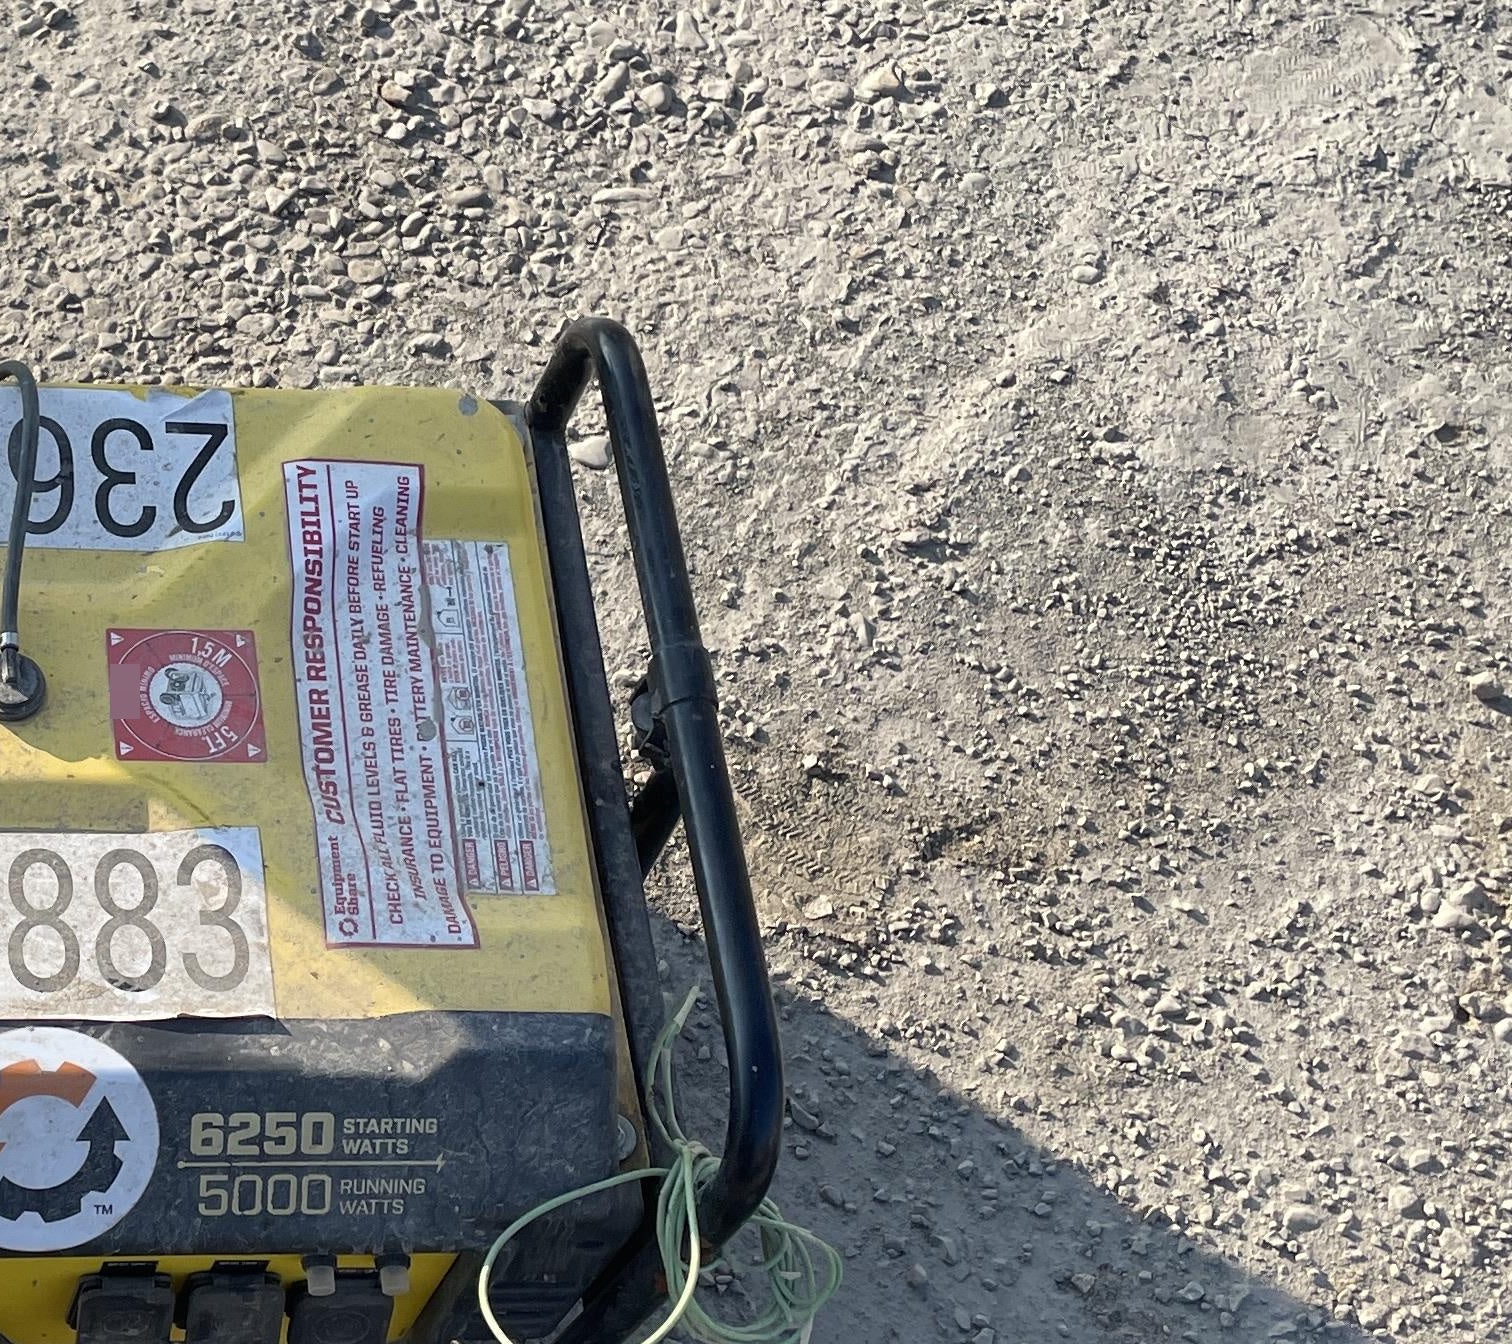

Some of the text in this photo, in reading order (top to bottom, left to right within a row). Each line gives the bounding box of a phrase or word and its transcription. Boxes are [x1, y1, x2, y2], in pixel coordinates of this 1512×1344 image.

[213, 649, 232, 667] M
[296, 465, 345, 824] CUSTOMER RESPONSIBILITY
[345, 480, 403, 924] CHECK ALL FLUID LEVELS & GREASE DAILY BEFORE START UP
[372, 507, 427, 900] INSURANCE FLAT TIRES TIRE DAMAGE REFUELING
[395, 476, 461, 934] DAMAGE TO EQUIPMENT TTERY MAINTENANCE CLEANING
[220, 725, 238, 742] 5
[328, 836, 345, 915] Equipment
[466, 841, 477, 875] DANGER
[347, 874, 359, 915] Share
[190, 1112, 334, 1156] 6250
[342, 1138, 409, 1155] WATTS
[343, 1117, 437, 1135] STARTING
[198, 1174, 332, 1216] 5000
[338, 1199, 405, 1215] WATTS
[339, 1178, 426, 1196] RUNNING
